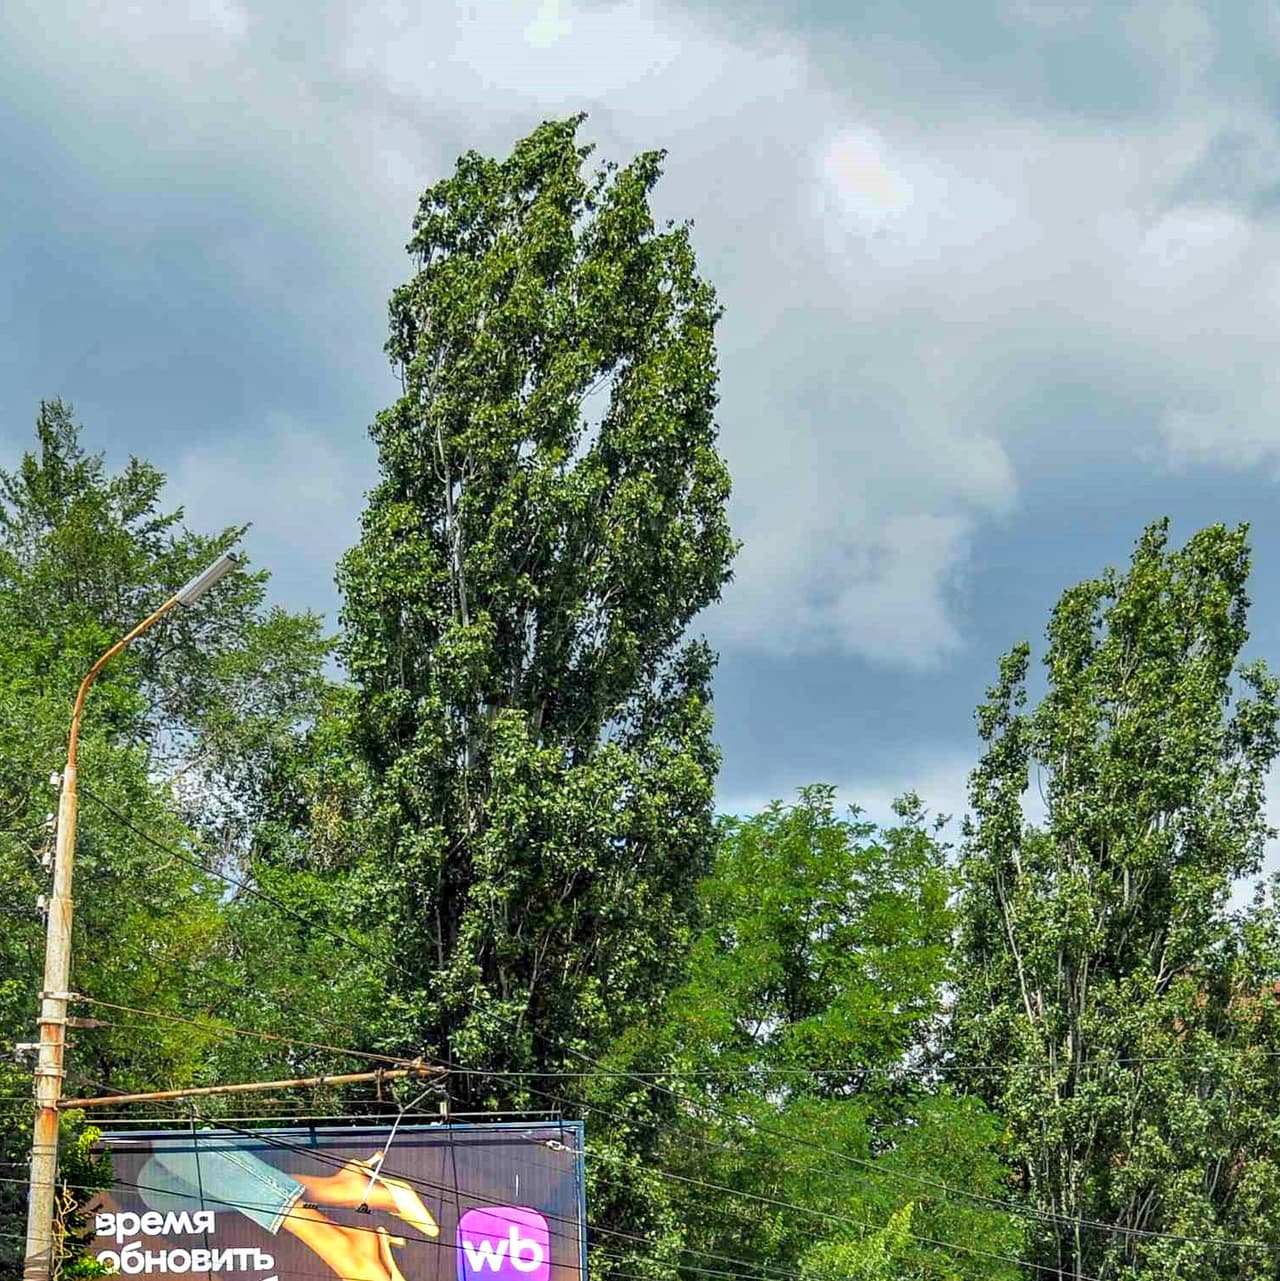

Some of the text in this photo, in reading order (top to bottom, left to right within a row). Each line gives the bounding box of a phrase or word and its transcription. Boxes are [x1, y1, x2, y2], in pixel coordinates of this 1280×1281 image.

[95, 1210, 215, 1243] время
[96, 1241, 275, 1274] обновить
[462, 1226, 543, 1273] wb
